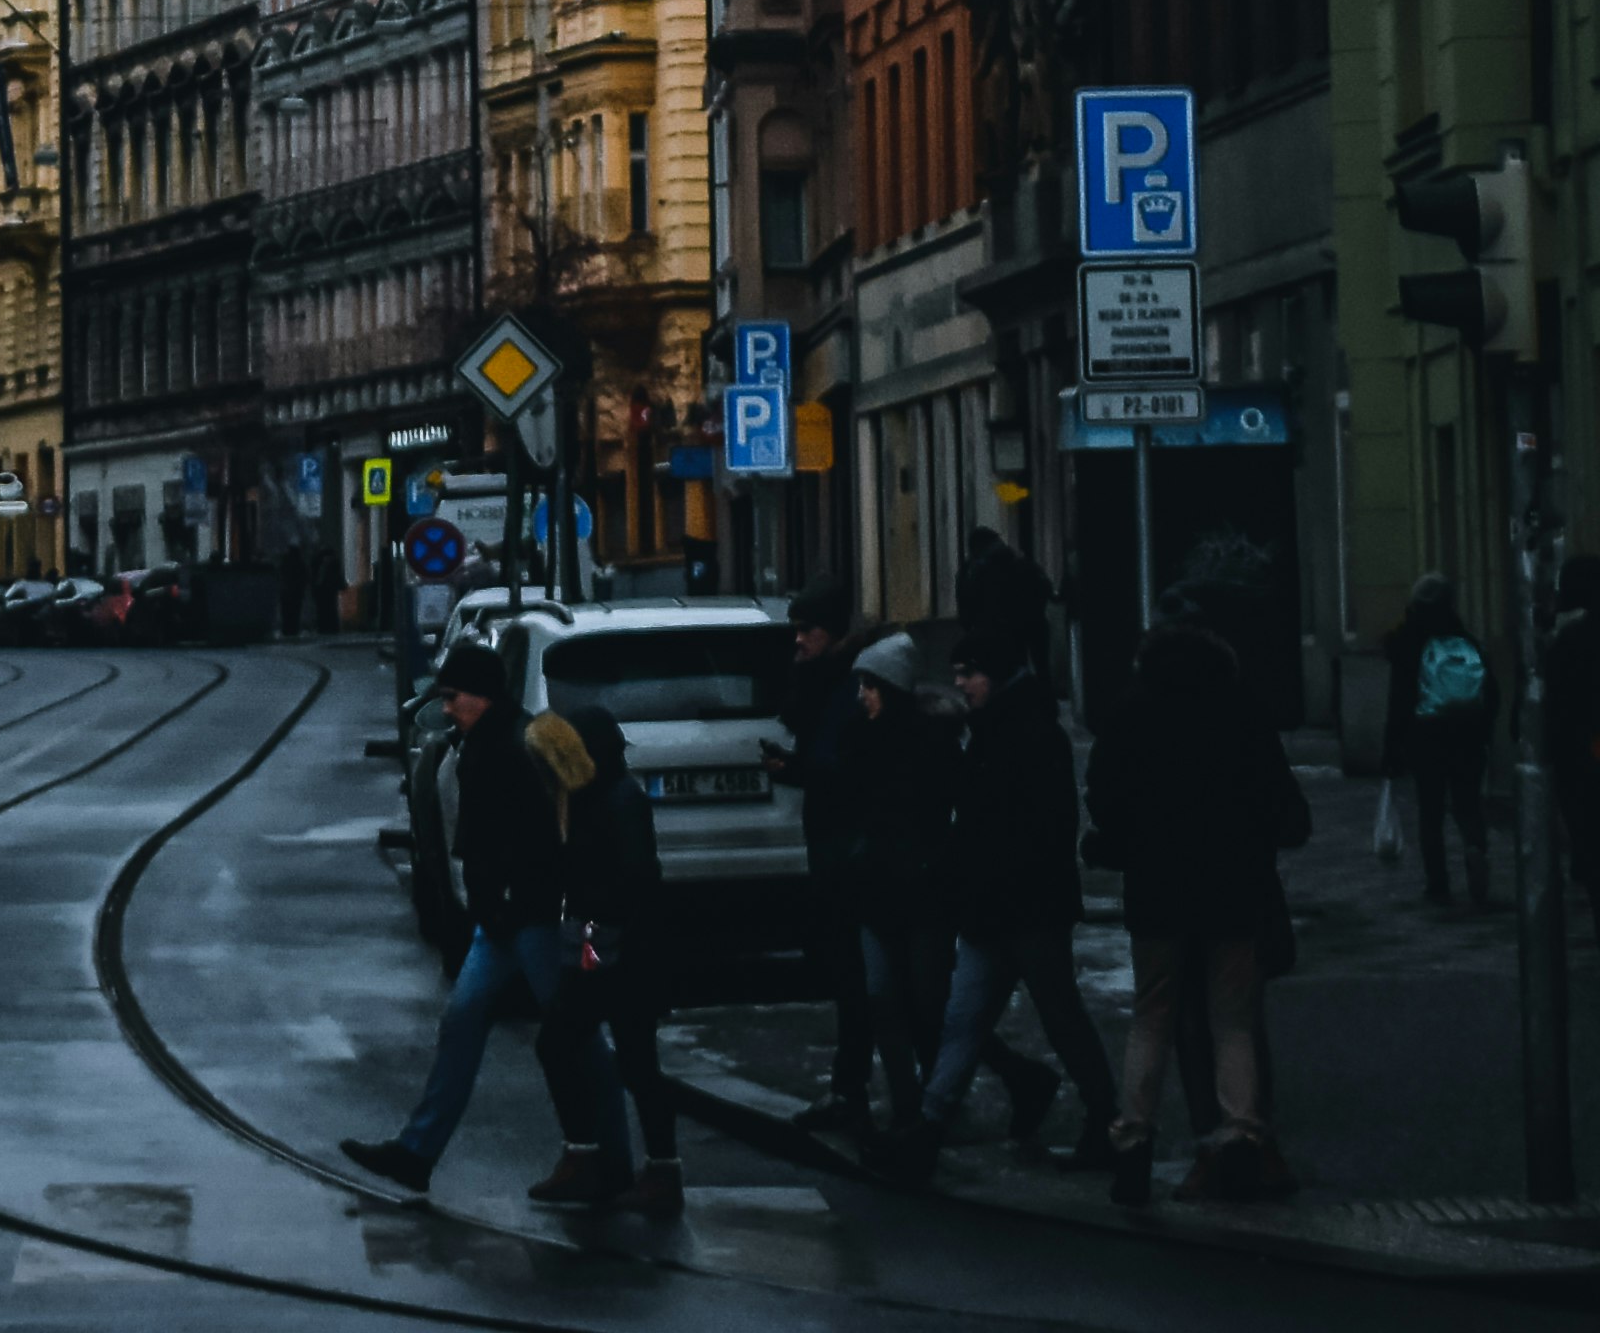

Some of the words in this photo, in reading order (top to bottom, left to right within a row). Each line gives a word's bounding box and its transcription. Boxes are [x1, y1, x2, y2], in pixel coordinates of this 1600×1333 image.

[1103, 110, 1169, 205] P
[746, 330, 778, 376] P
[736, 395, 771, 447] P
